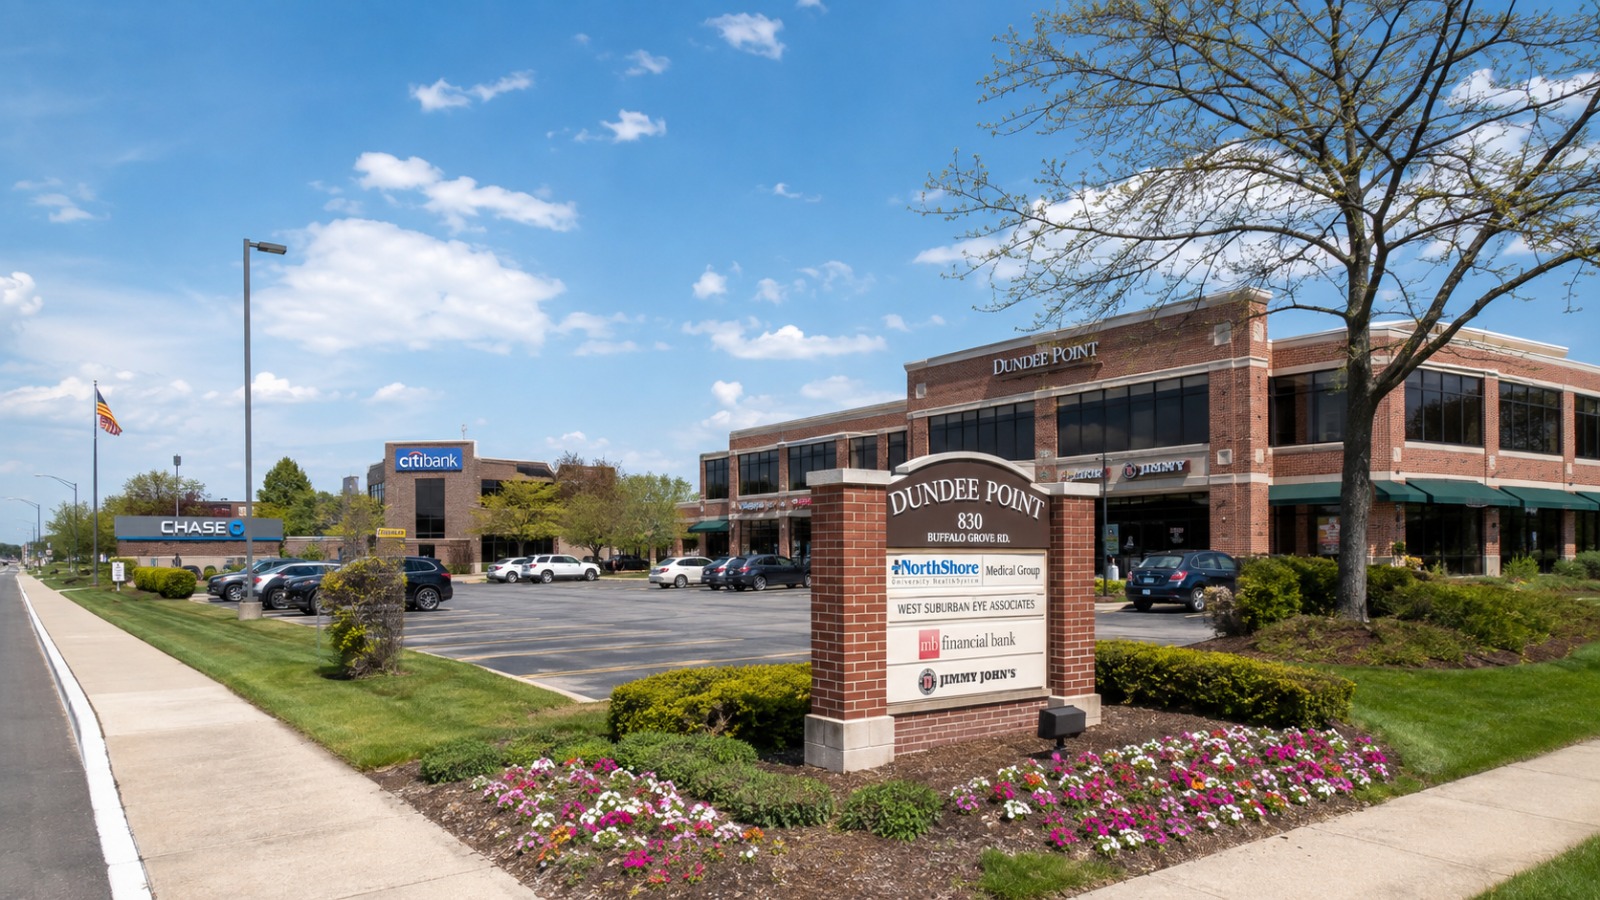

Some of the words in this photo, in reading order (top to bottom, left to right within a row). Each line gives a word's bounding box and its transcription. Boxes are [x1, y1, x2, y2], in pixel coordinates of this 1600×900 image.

[993, 351, 1049, 376] DUNDEE
[1052, 341, 1099, 364] POINT
[399, 453, 458, 468] citibank
[888, 478, 980, 516] DUNDEE
[985, 480, 1045, 520] POINT
[161, 520, 226, 535] CHASE
[957, 513, 983, 530] 830
[927, 532, 966, 543] BUFFALO
[967, 532, 995, 543] GROVE
[997, 533, 1011, 544] RD.
[901, 559, 979, 576] NorthShore
[986, 565, 1015, 576] Medical
[1017, 565, 1041, 580] Group
[897, 603, 922, 615] WEST
[924, 601, 970, 614] SUBURBAN
[972, 600, 988, 612] EYE
[989, 599, 1035, 611] ASSOCIATES
[920, 634, 939, 651] mb
[942, 633, 989, 651] financial
[990, 631, 1016, 647] bank
[939, 672, 977, 688] JIMMY
[980, 668, 1016, 684] JOHN'S
